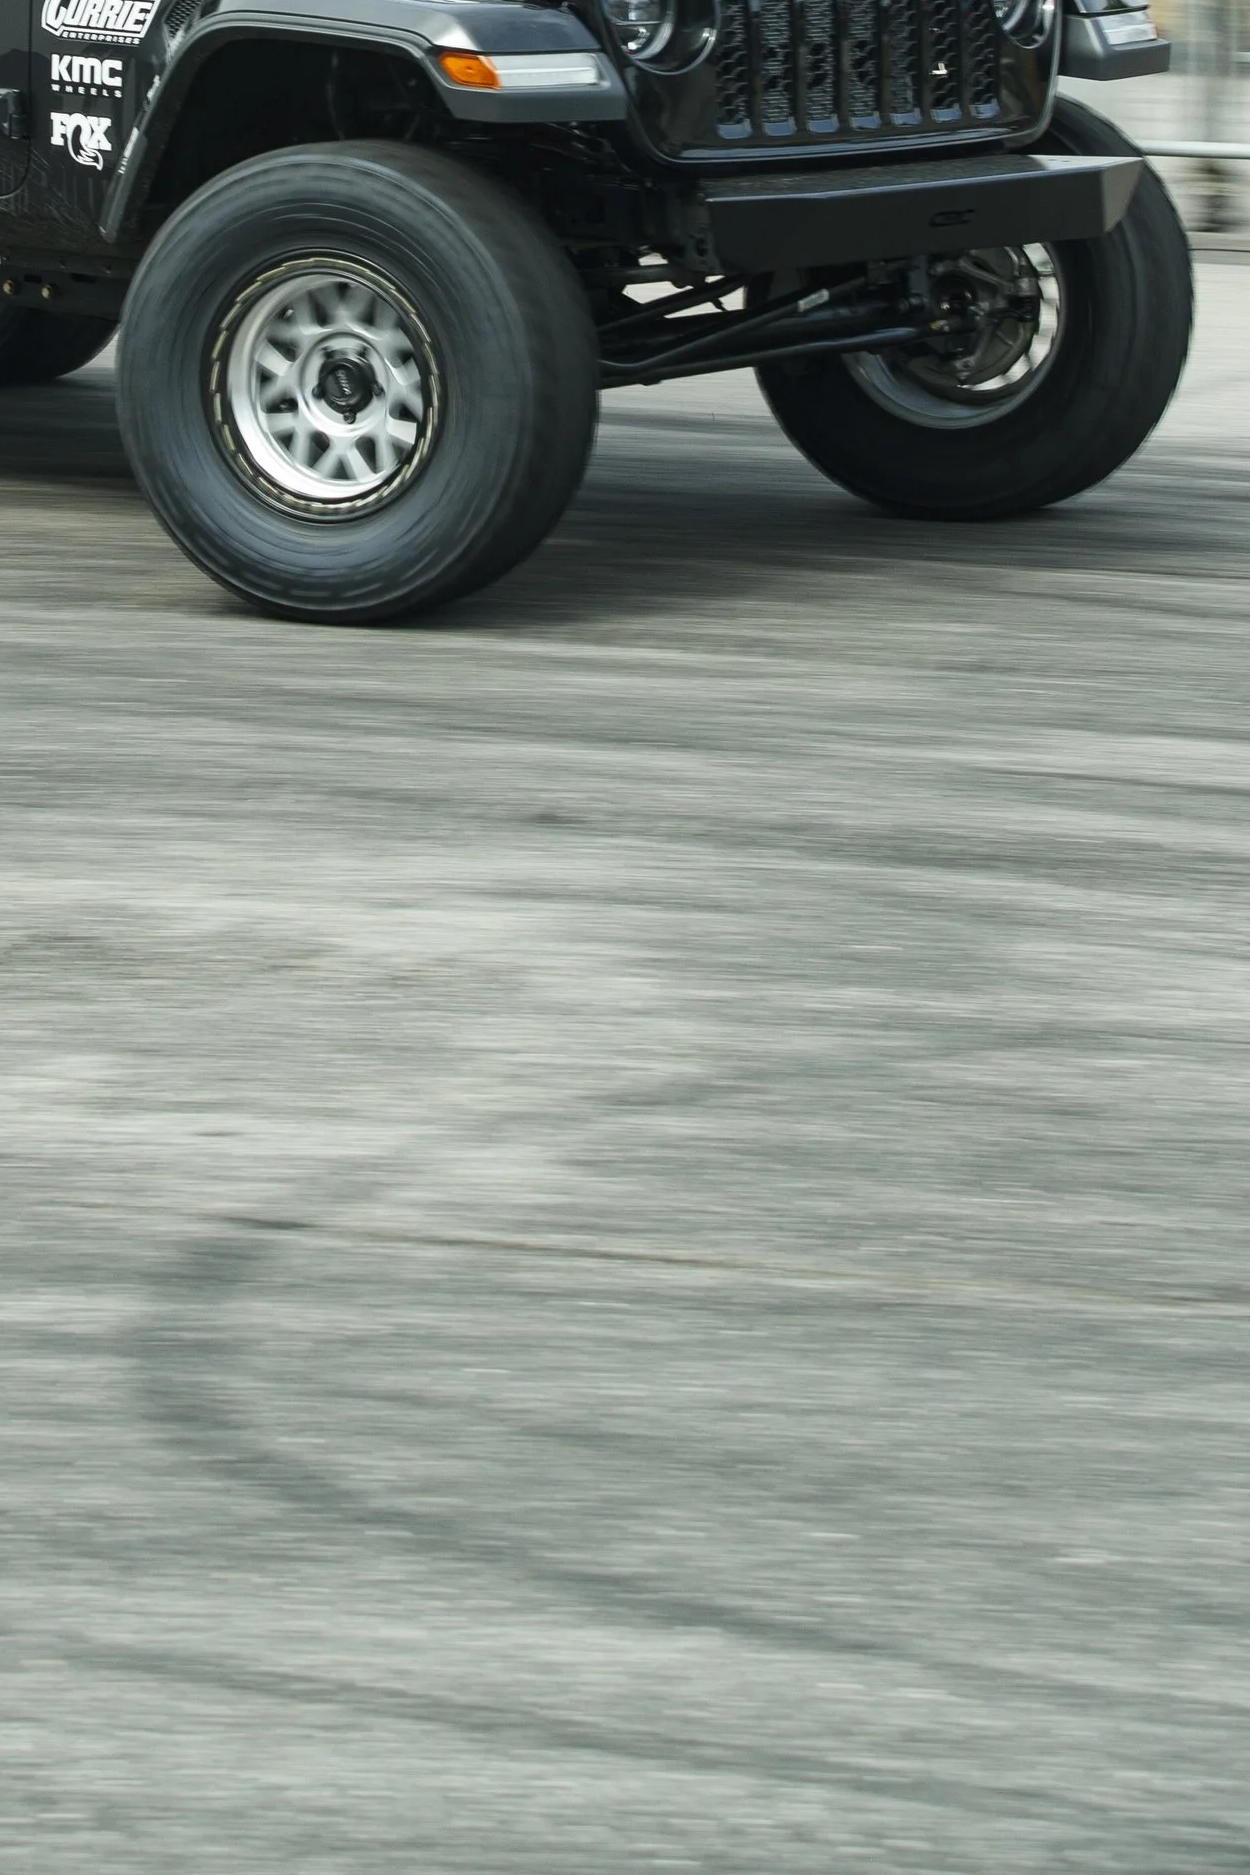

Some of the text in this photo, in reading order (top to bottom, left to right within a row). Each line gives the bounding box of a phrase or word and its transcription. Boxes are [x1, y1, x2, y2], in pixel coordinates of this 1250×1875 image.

[61, 31, 141, 45] ENTERPRISES
[50, 83, 123, 98] WHEELS
[50, 111, 112, 171] FOX
